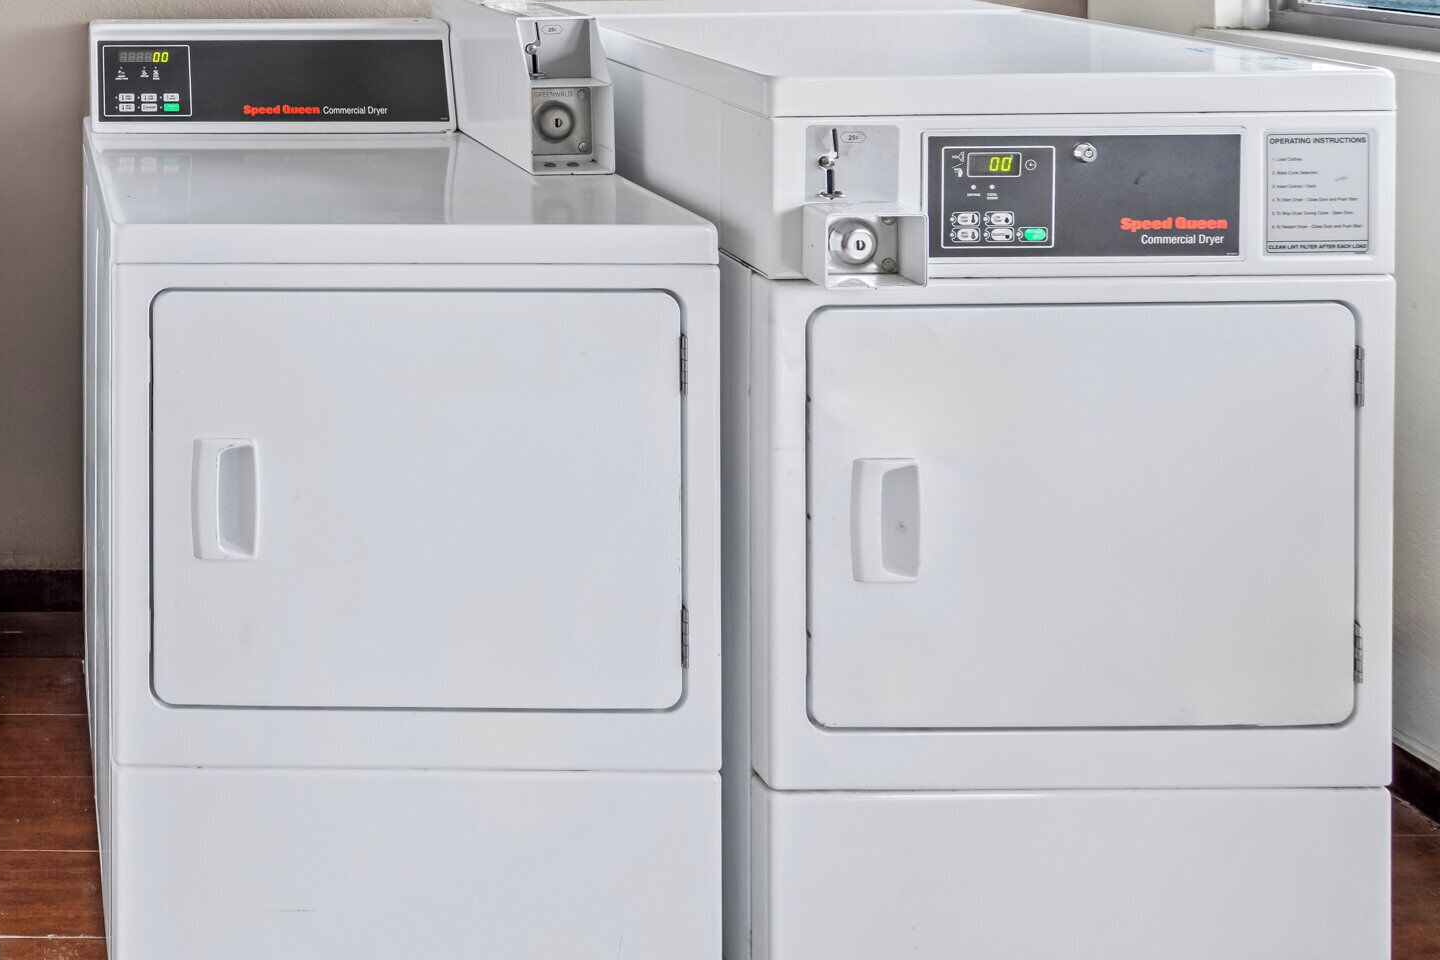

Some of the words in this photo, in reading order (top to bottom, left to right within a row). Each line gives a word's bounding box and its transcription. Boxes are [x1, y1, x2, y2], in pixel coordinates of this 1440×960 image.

[243, 104, 280, 116] Speed
[282, 104, 320, 115] Queen
[323, 106, 366, 114] Commercial
[367, 106, 388, 116] Dryer
[989, 157, 1012, 172] 00
[1120, 217, 1173, 232] Speed
[1175, 217, 1228, 229] Queen
[1141, 234, 1196, 244] Commercial
[1199, 235, 1224, 245] Dryer
